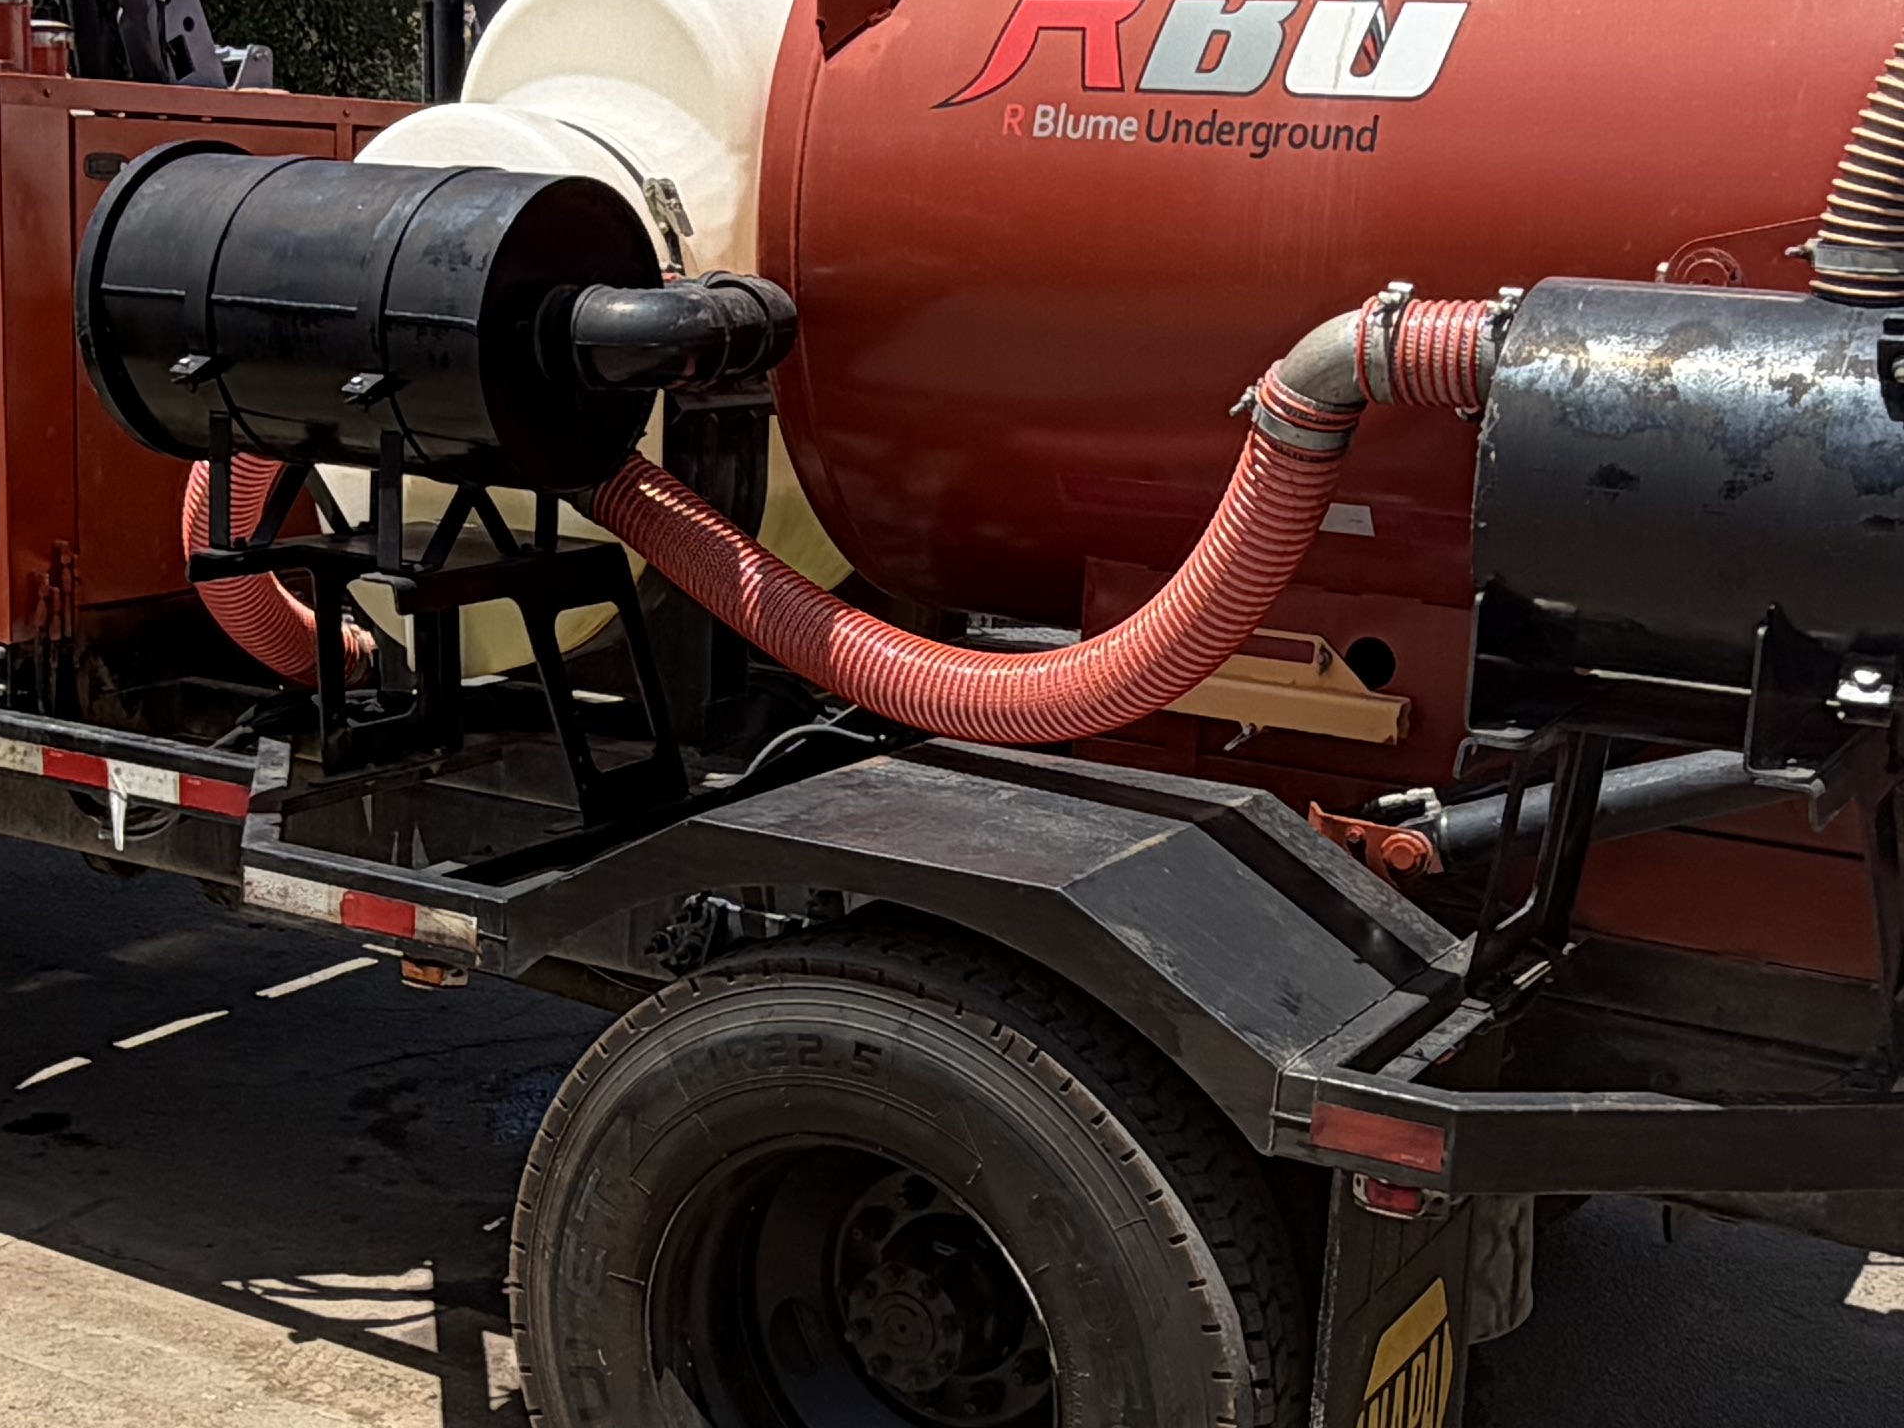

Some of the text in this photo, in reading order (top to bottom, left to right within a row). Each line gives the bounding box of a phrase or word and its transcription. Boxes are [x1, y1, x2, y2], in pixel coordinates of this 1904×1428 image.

[1002, 102, 1380, 159] R Blume Underground
